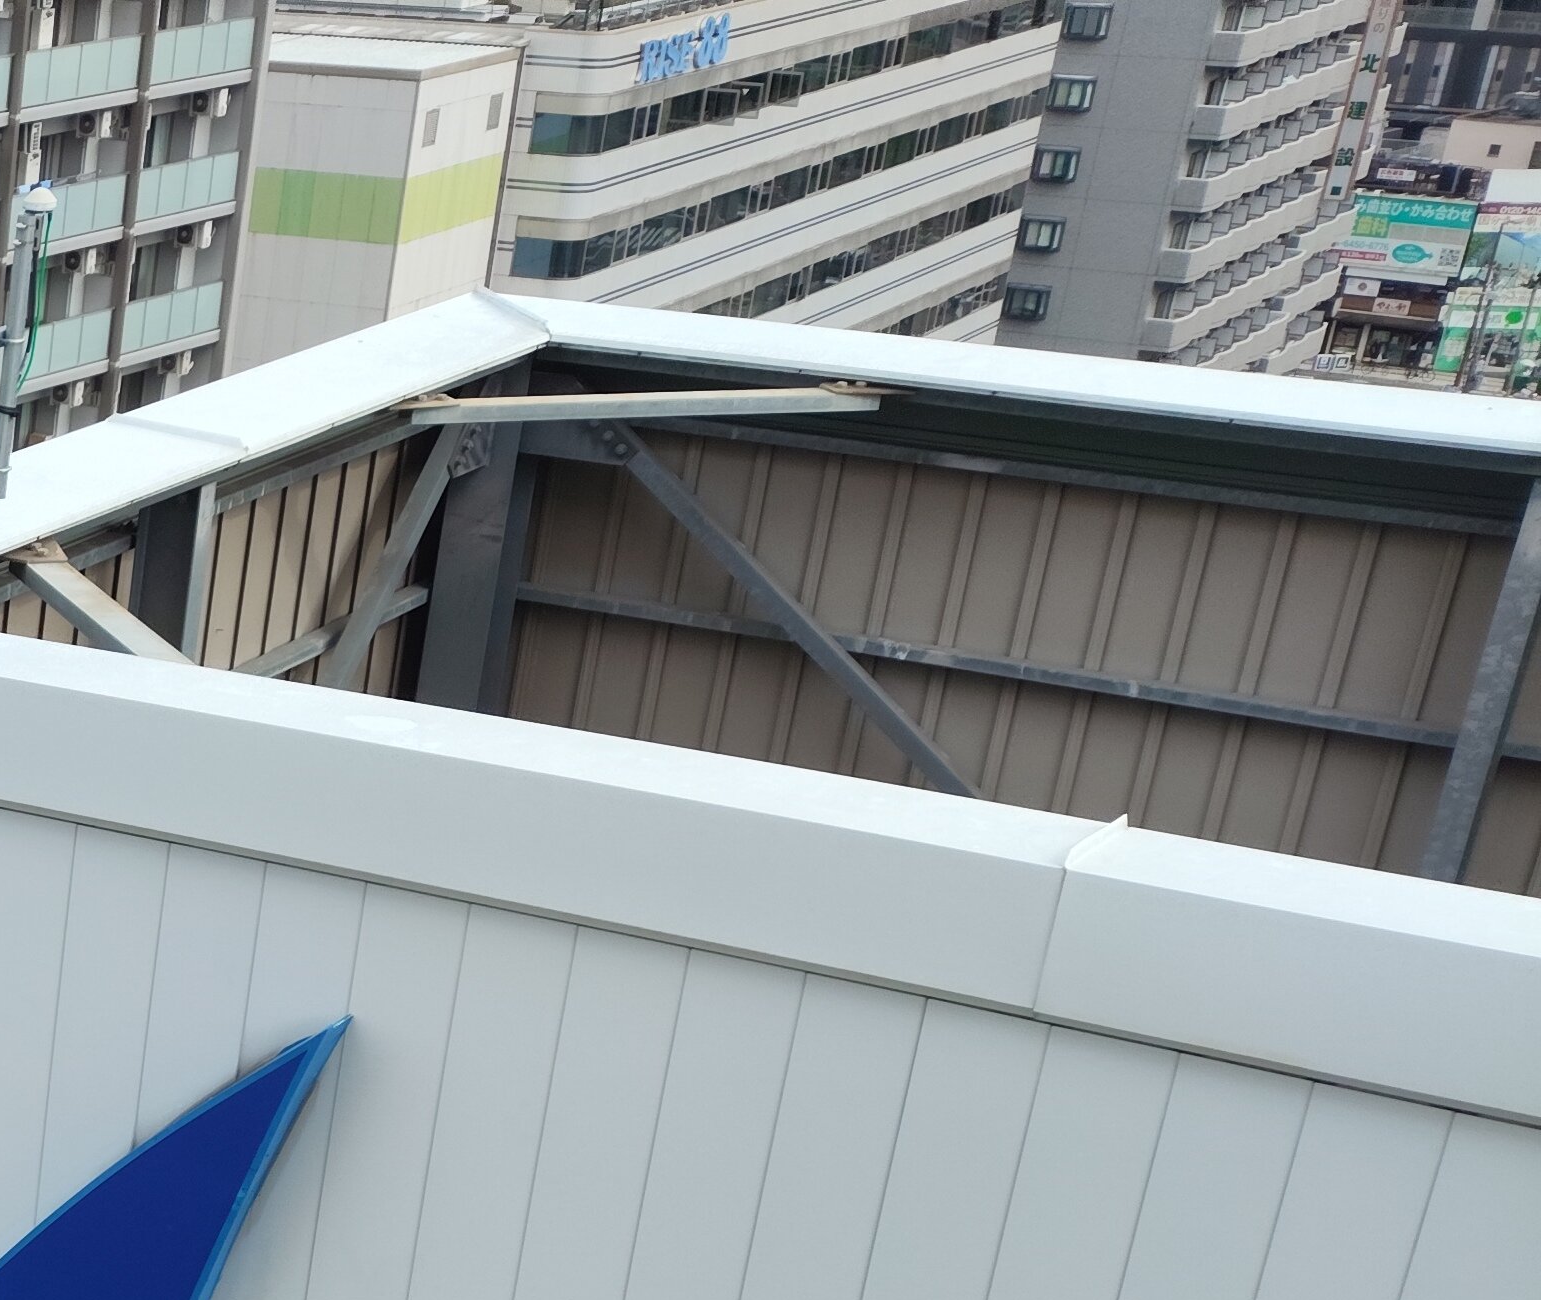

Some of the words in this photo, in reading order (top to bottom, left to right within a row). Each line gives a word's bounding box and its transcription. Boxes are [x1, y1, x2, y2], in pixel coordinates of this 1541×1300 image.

[639, 31, 696, 83] RISE
[697, 12, 731, 68] 88
[1334, 54, 1381, 167] 北建設
